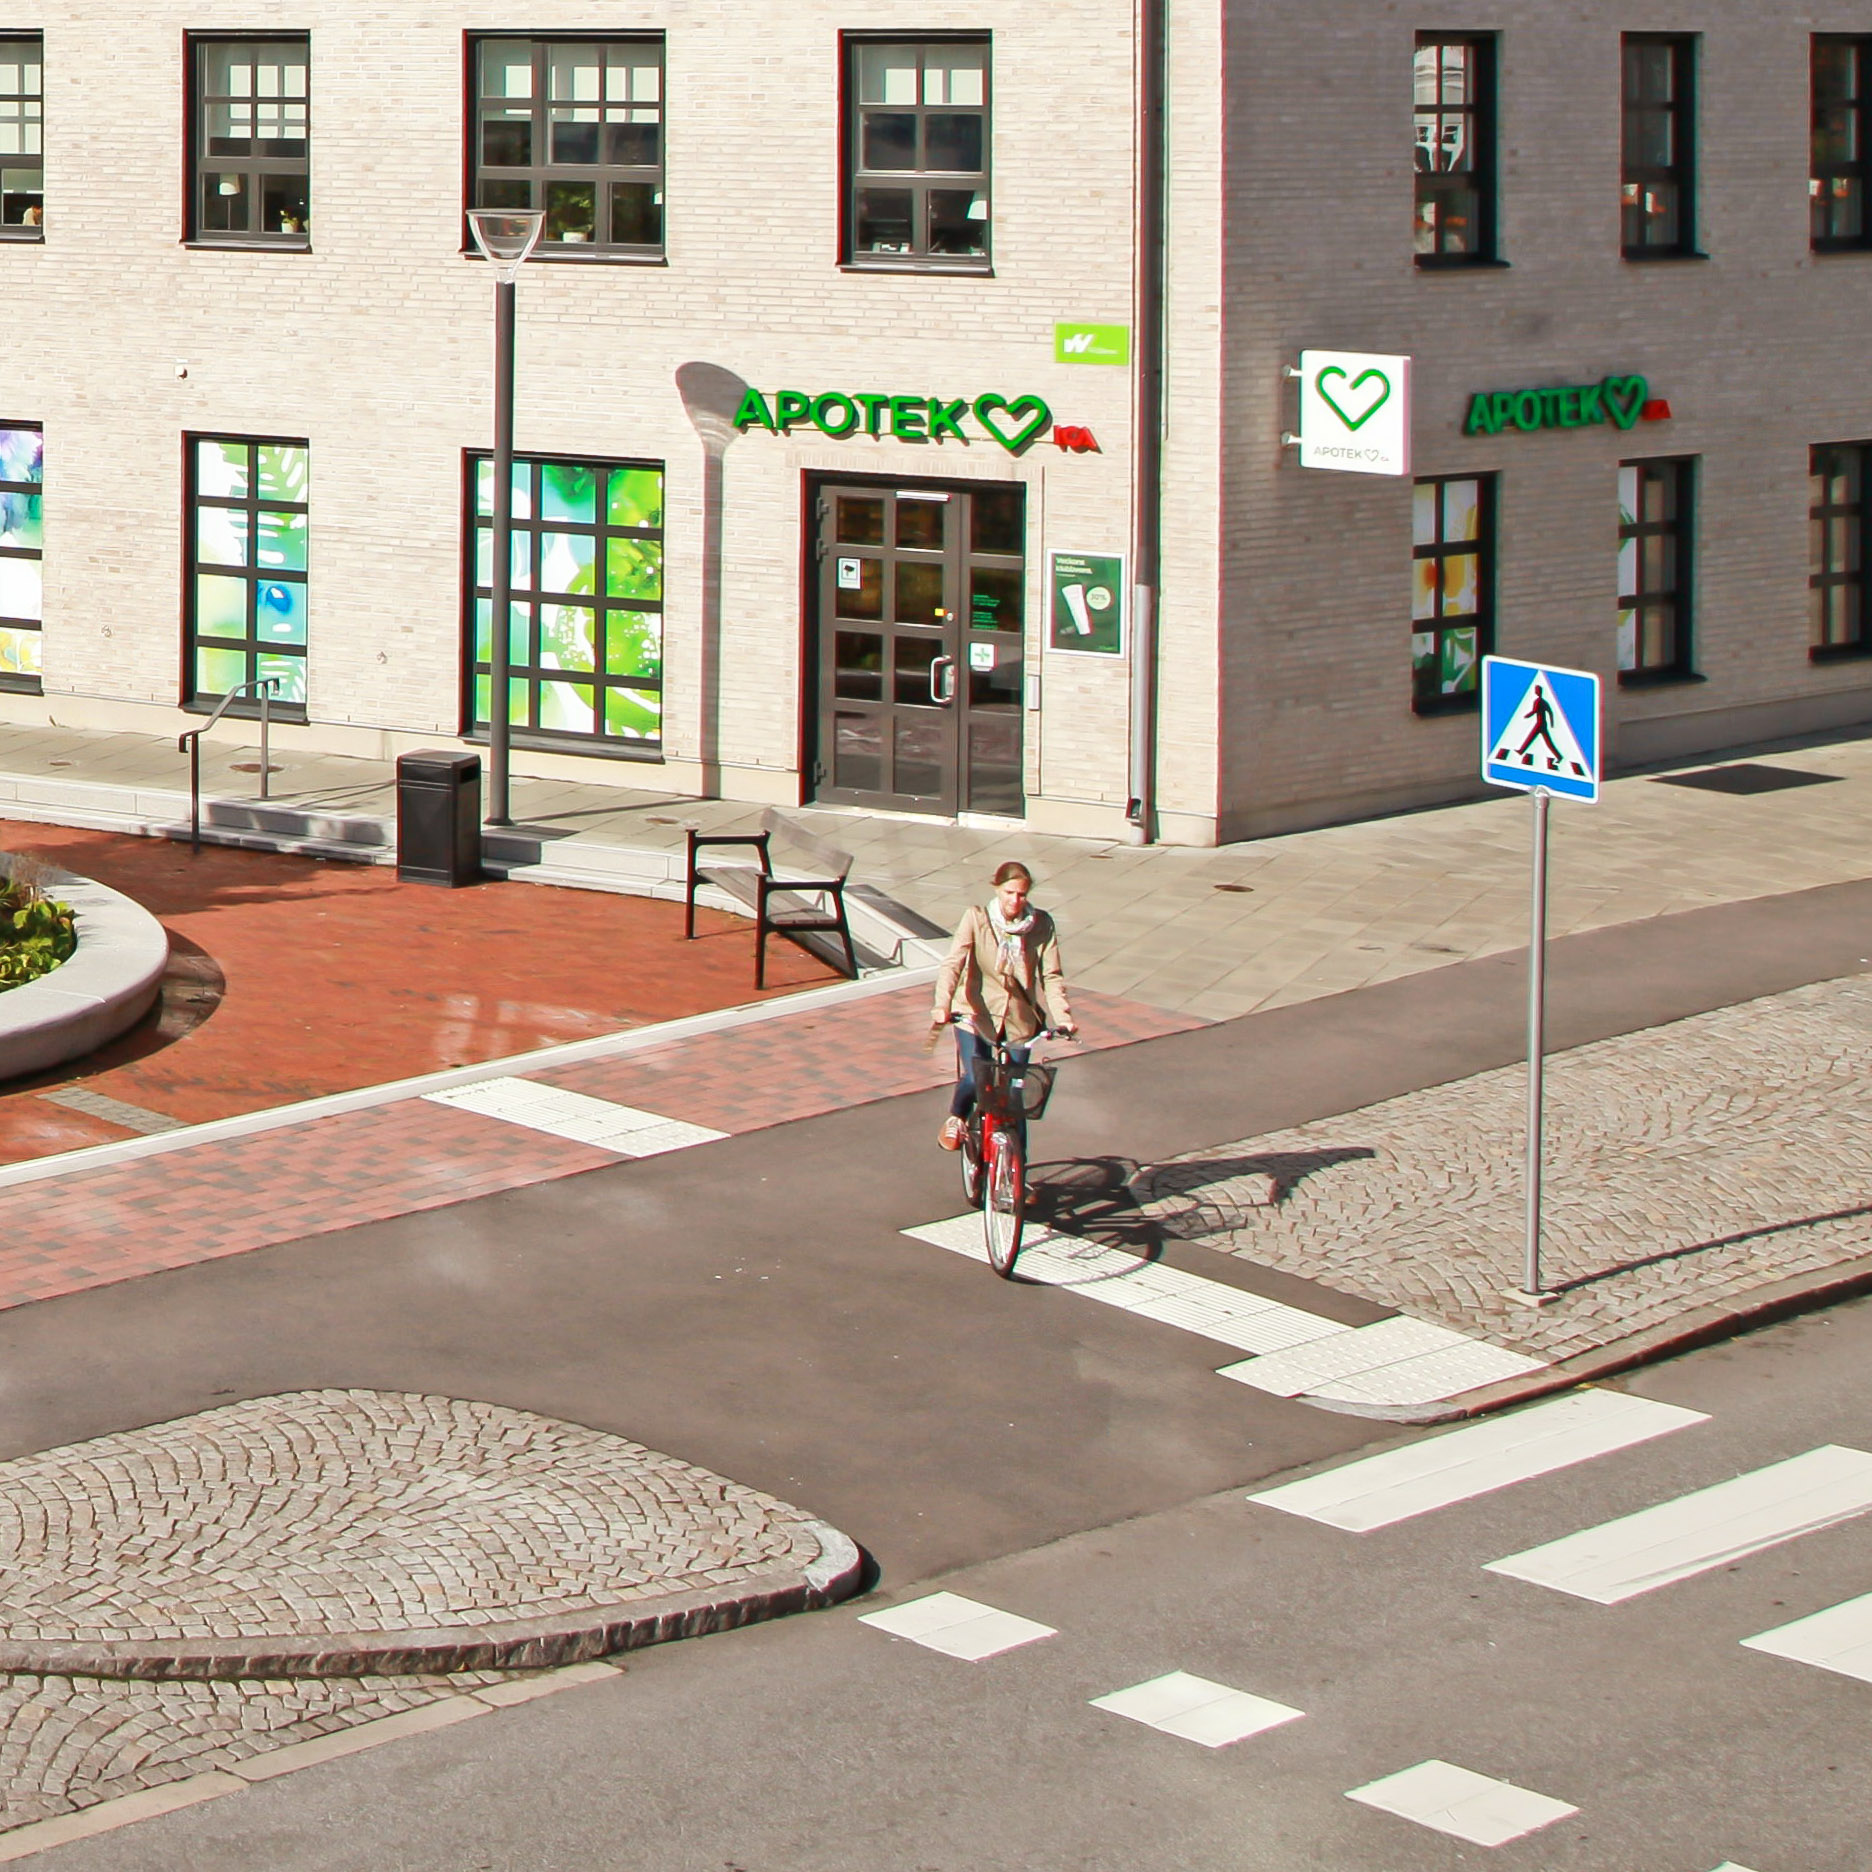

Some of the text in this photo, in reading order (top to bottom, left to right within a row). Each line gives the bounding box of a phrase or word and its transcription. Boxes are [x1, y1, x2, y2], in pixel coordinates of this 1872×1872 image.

[733, 388, 1098, 450] APOTEK ICA
[1464, 385, 1606, 436] APOTEK
[1313, 446, 1362, 459] APOTEK
